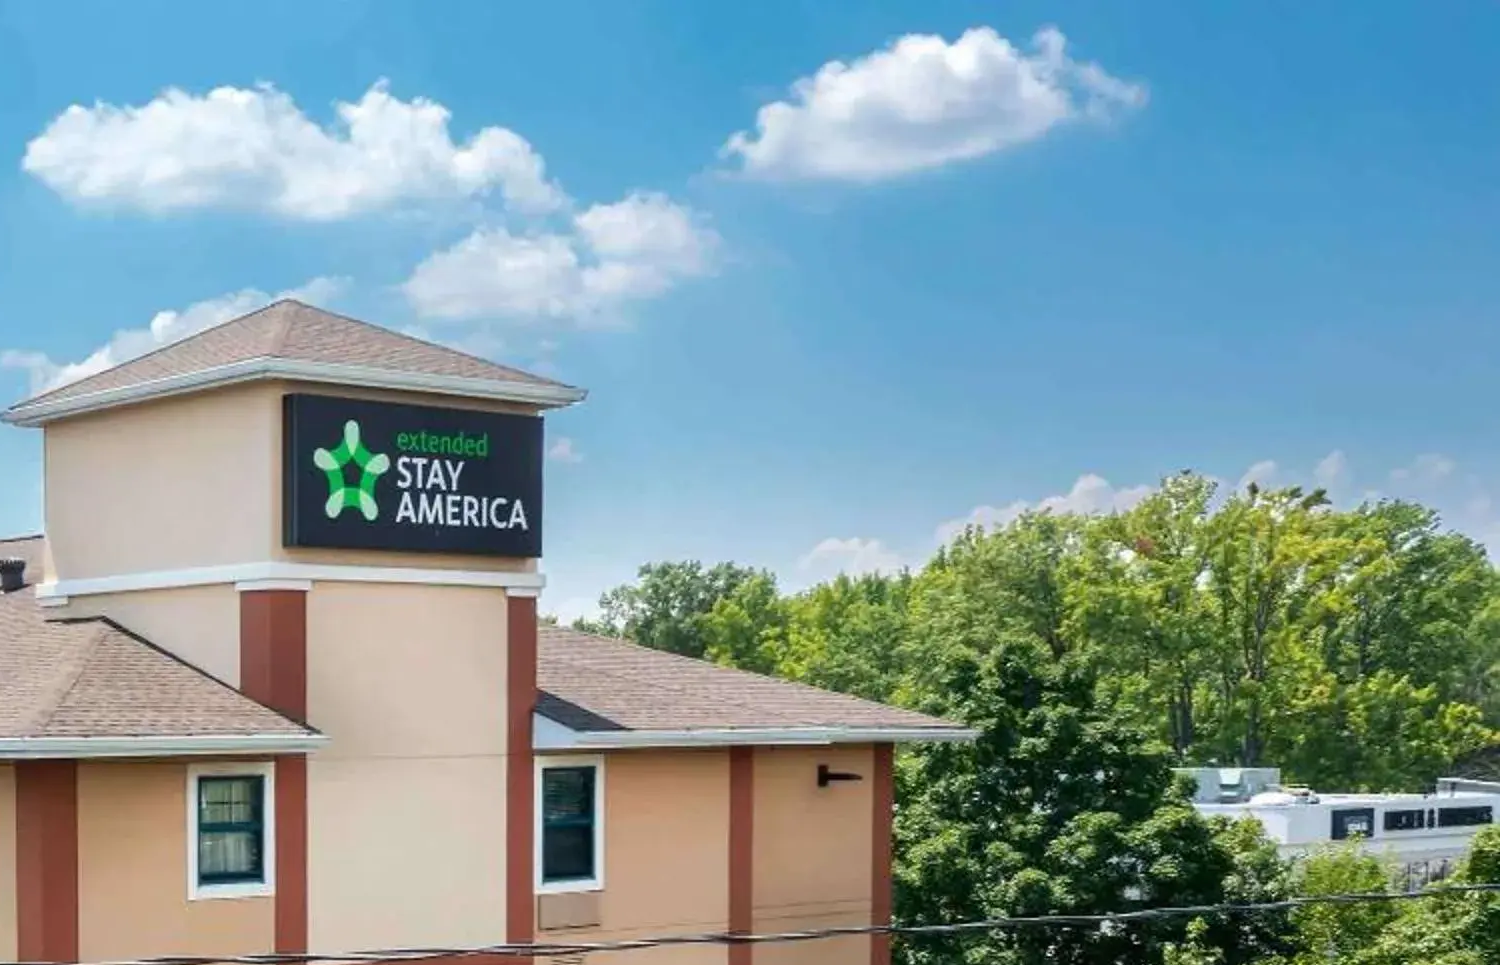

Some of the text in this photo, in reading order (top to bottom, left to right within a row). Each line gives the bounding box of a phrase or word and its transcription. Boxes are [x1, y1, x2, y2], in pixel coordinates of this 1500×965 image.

[396, 431, 487, 456] extended
[396, 457, 464, 491] STAY
[396, 492, 528, 530] AMERICA
